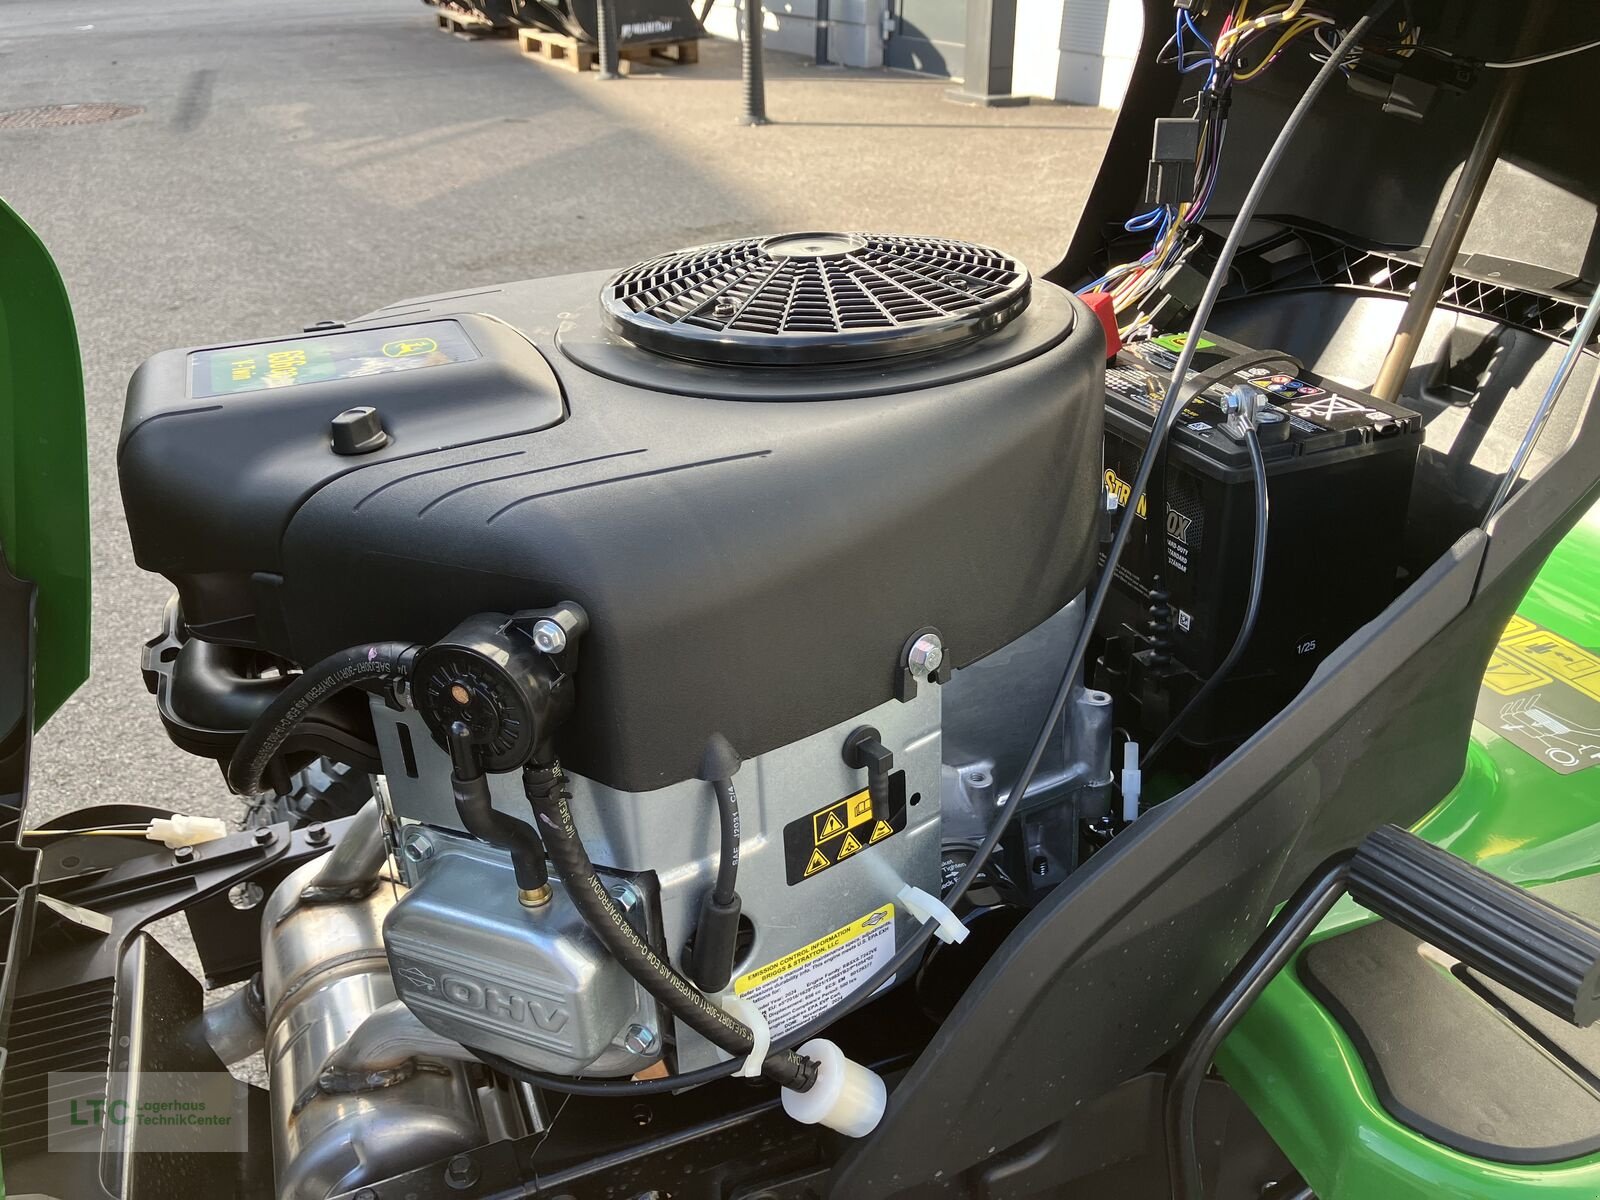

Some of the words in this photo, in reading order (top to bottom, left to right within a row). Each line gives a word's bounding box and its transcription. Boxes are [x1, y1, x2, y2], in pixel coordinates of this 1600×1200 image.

[1104, 468, 1146, 520] STRN
[1166, 504, 1192, 544] OX
[1297, 640, 1316, 654] 1/25
[306, 677, 336, 702] DAYPERM
[295, 696, 310, 711] AIS
[732, 847, 740, 866] SAE
[620, 921, 648, 956] Q-19-082
[646, 953, 661, 970] EQ#
[747, 962, 778, 980] EMISSION
[779, 947, 809, 965] CONTROL
[810, 927, 850, 950] INFORMATION
[761, 965, 785, 981] BRIGGS
[793, 945, 826, 965] STRATTON,
[827, 940, 839, 948] LLC
[774, 973, 798, 988] durability
[812, 961, 822, 969] This
[823, 952, 840, 964] engine
[841, 944, 856, 954] meets
[867, 932, 878, 941] EPA
[660, 965, 672, 980] AIS
[739, 988, 754, 998] Refer
[762, 975, 782, 988] owner's
[784, 965, 803, 977] manual
[812, 945, 843, 964] maintenance
[669, 976, 700, 1005] DAYPERM
[784, 989, 796, 997] 2024
[806, 976, 823, 987] Engine
[441, 974, 569, 1034] OHV
[786, 1010, 806, 1022] requires
[807, 1003, 818, 1011] EPA
[819, 997, 829, 1005] EVP
[792, 996, 820, 1013] Compliance
[803, 1004, 827, 1018] November
